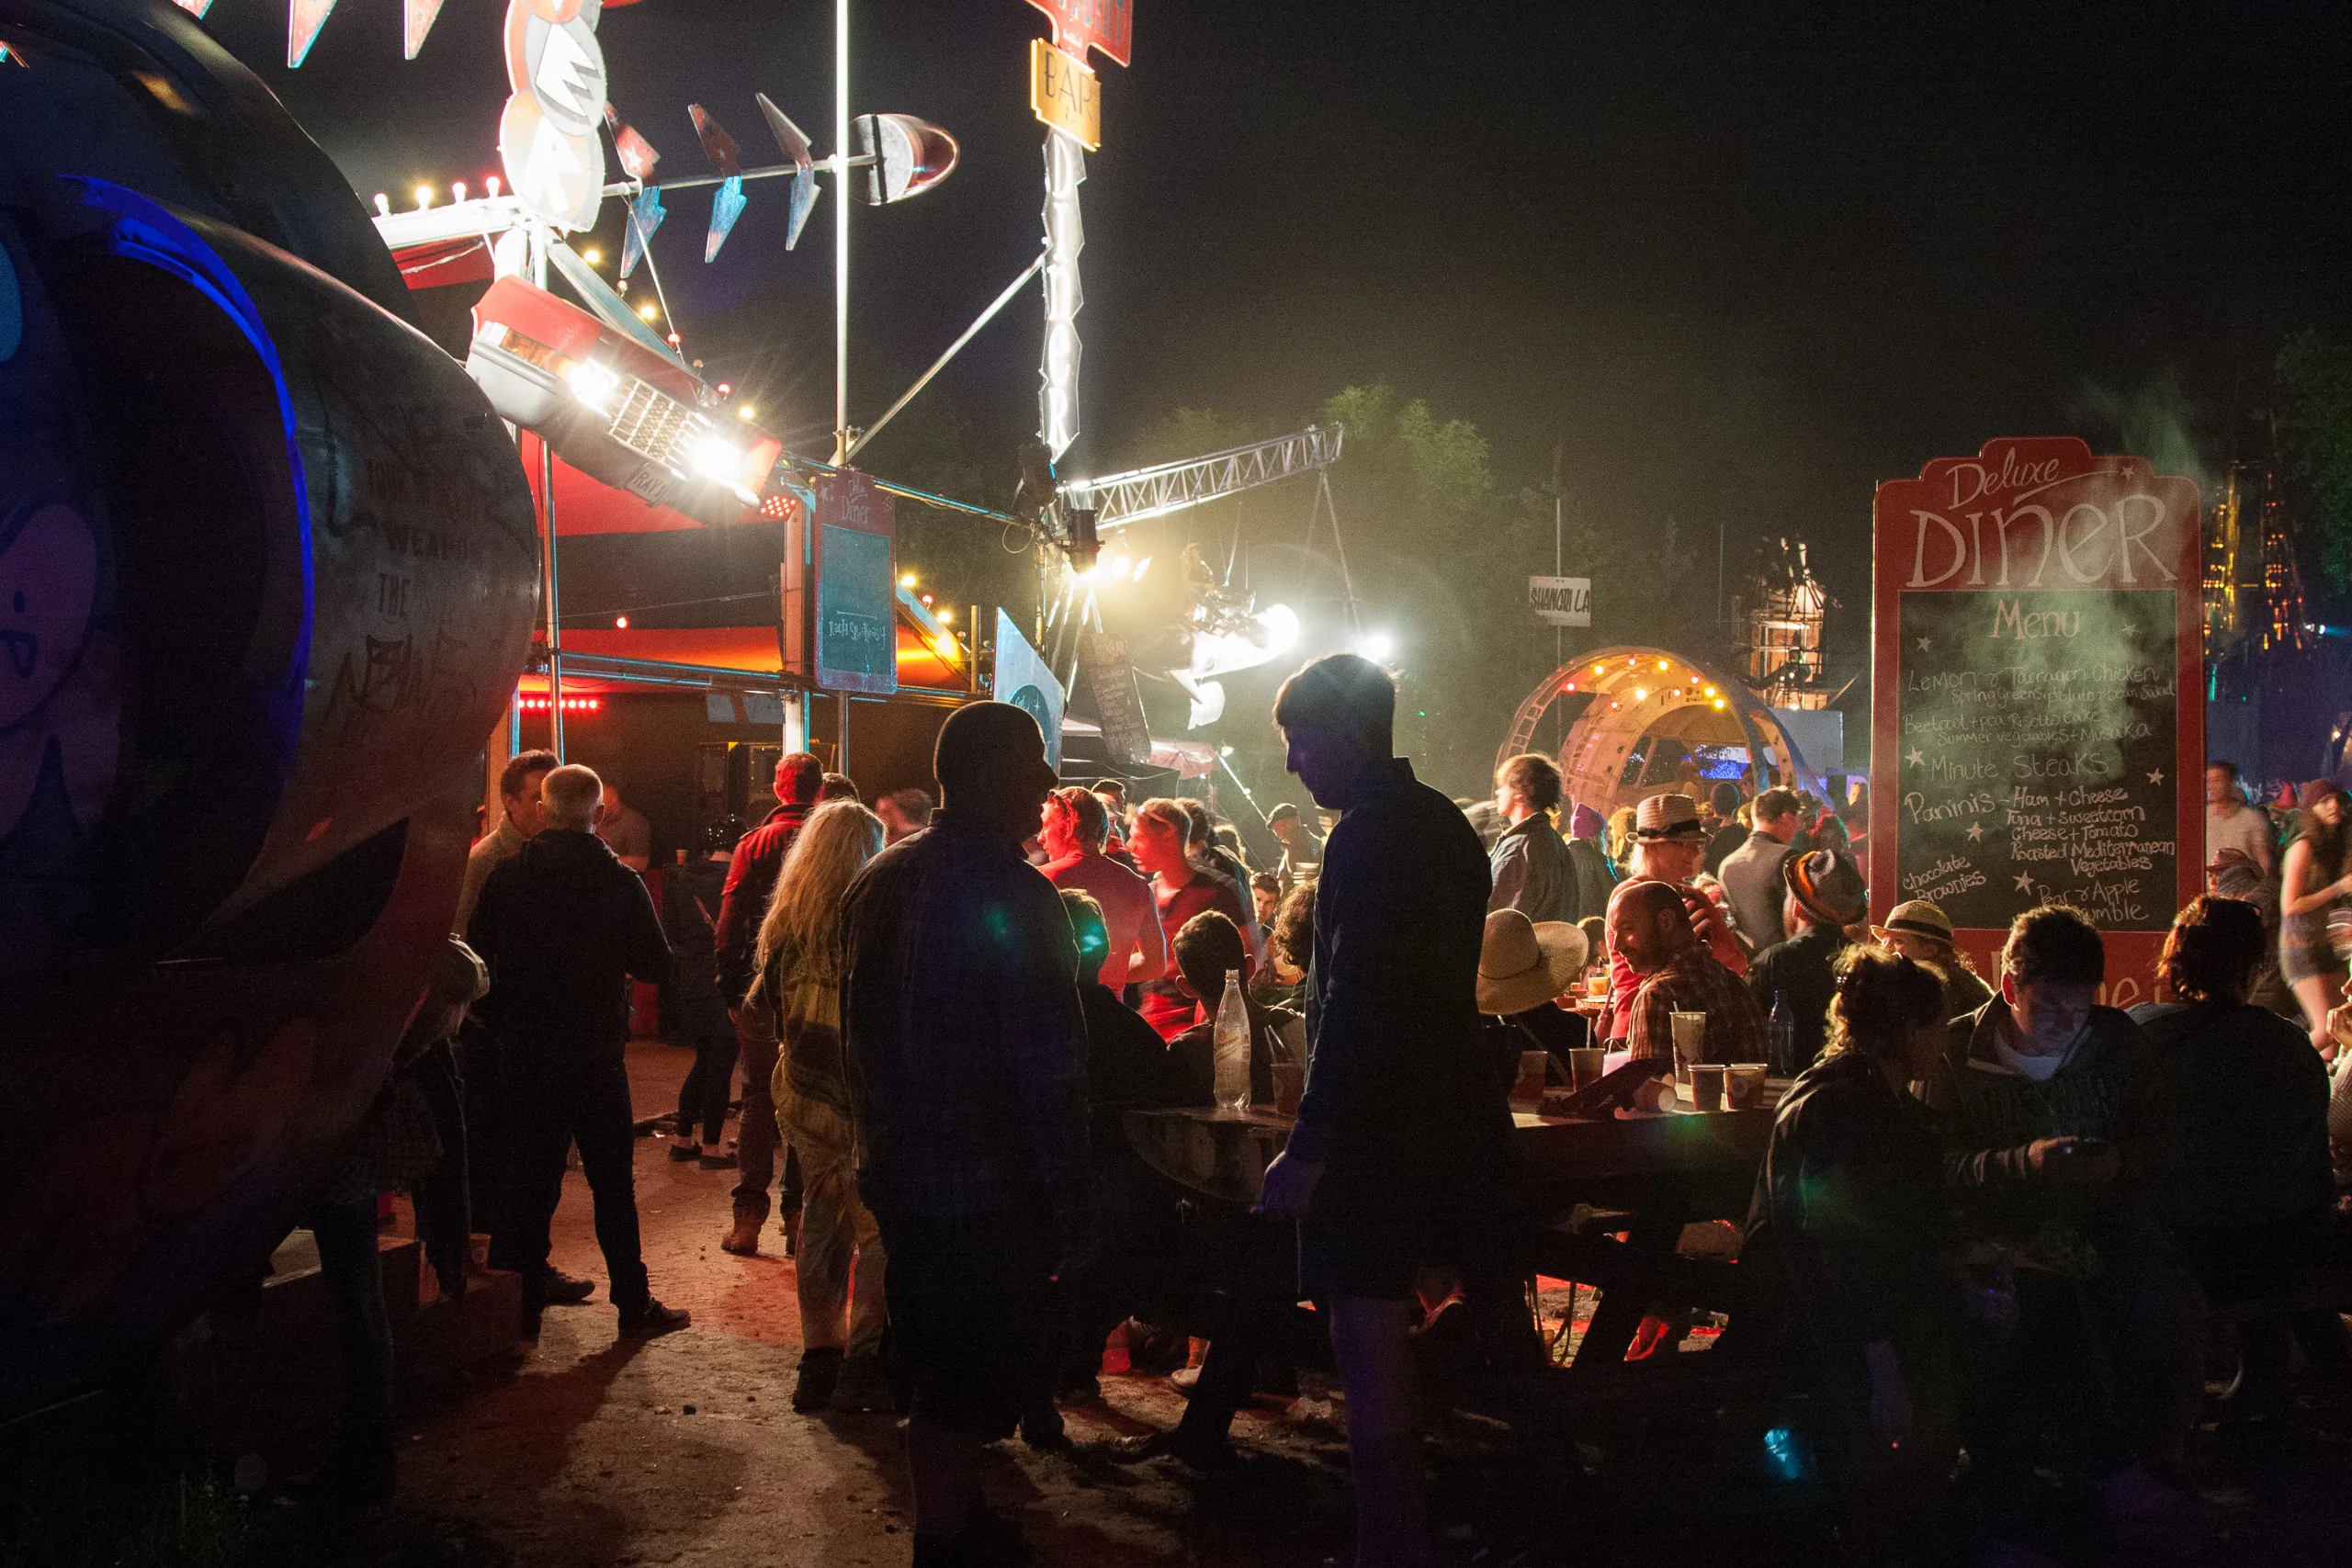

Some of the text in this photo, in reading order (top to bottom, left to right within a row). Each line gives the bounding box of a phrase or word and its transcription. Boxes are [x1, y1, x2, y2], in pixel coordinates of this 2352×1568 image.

[1044, 50, 1094, 123] BAR
[1946, 446, 2060, 510] Deluxe
[1989, 598, 2081, 640] Menu
[1931, 754, 1999, 782] Minute
[1904, 791, 1996, 825] Paninis
[2013, 785, 2129, 808] Ham + Cheese
[2007, 808, 2042, 827] Tuna
[2047, 811, 2056, 825] +
[2011, 822, 2139, 841] Cheese + Tomato
[2010, 840, 2176, 862] Roasted Mediterranean
[2070, 856, 2154, 878] Vegetables
[1913, 870, 1987, 904] Brownies
[2036, 884, 2071, 907] Pear
[2092, 876, 2141, 906] Apple
[2083, 898, 2150, 922] umble
